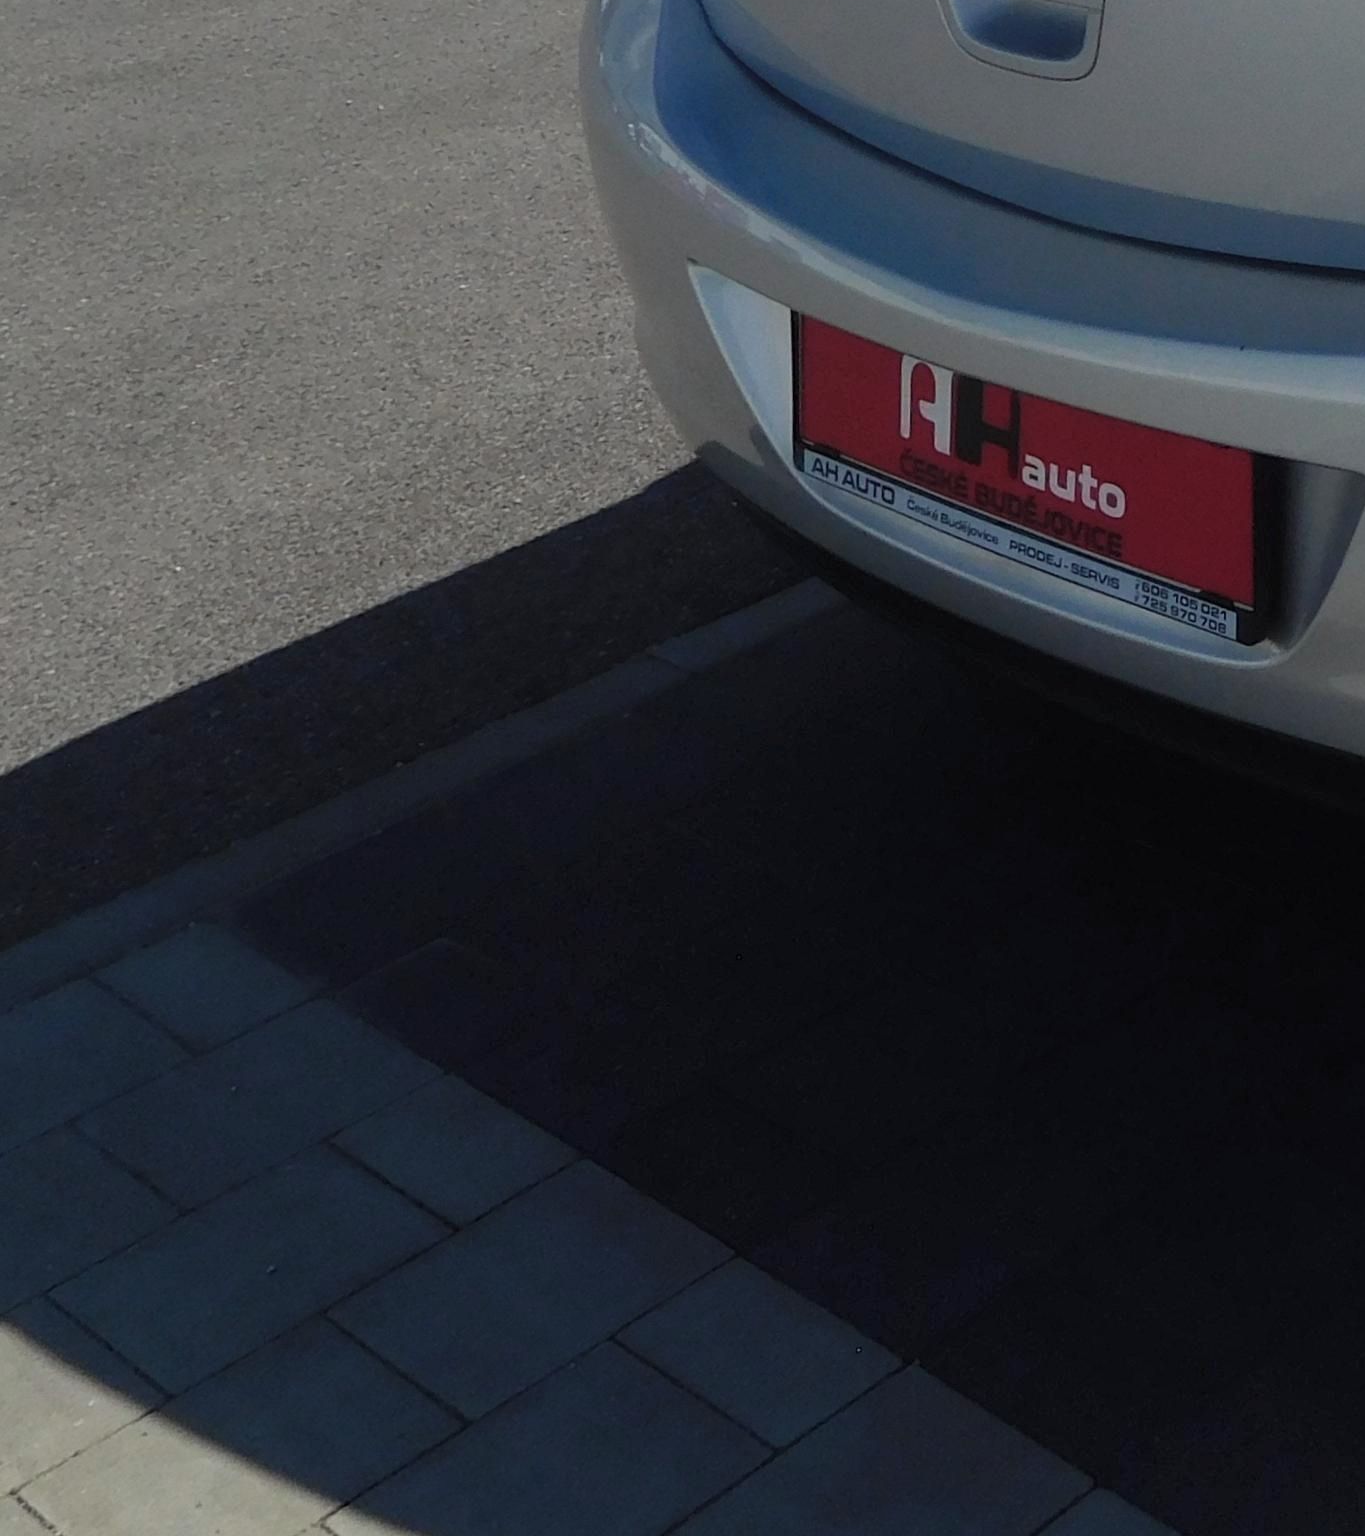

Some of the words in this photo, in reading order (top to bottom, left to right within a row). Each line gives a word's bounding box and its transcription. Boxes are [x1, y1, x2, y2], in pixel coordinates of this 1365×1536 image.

[811, 457, 838, 482] AH
[842, 470, 895, 506] AUTO
[1009, 540, 1063, 568] PRODEJ
[1070, 563, 1120, 590] SERVIS
[1141, 594, 1168, 613] 725
[1199, 616, 1227, 634] 708
[1172, 593, 1198, 611] 105
[1201, 603, 1227, 621] 021
